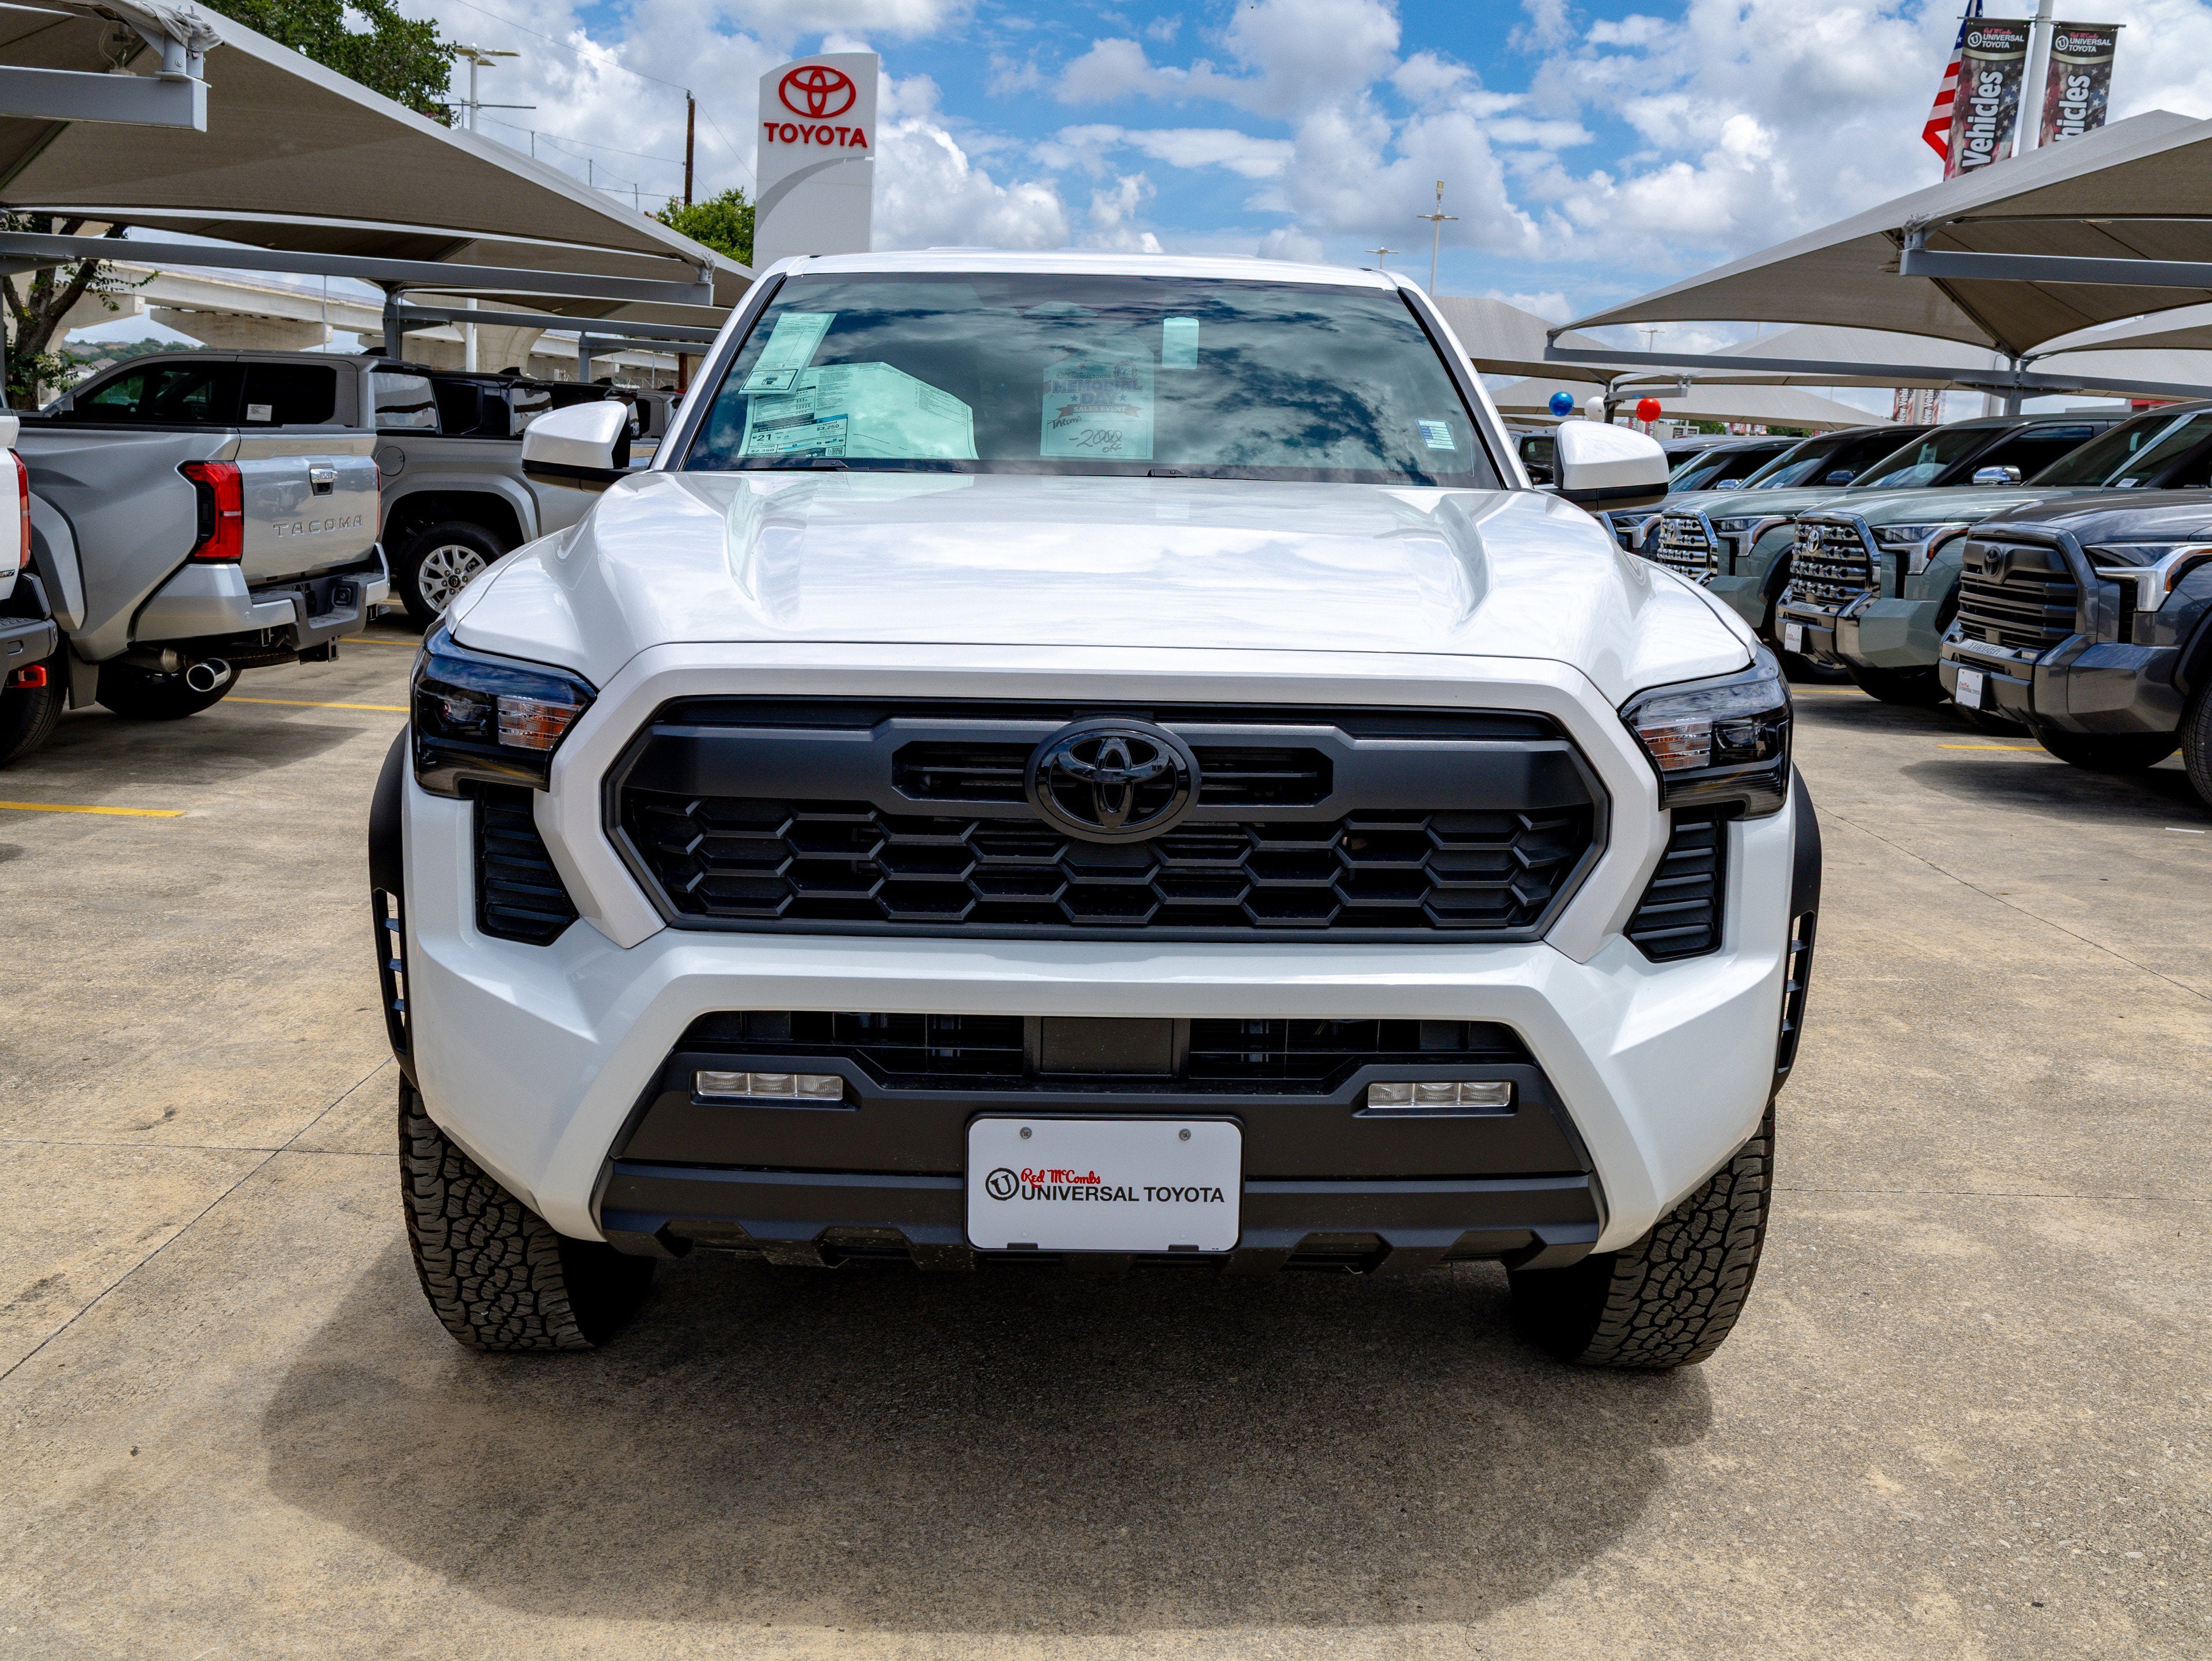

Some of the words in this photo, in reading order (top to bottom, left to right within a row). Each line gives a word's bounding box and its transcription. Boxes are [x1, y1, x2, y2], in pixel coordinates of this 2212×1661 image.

[1983, 33, 2024, 41] UNIVERSAL
[2070, 37, 2112, 46] UNIVERSAL
[1961, 71, 2003, 167] Vehicles
[764, 122, 868, 148] TOYOTA
[1053, 379, 1143, 393] MEMORIAL
[1080, 392, 1118, 405] DAY
[1897, 408, 1907, 423] New
[1922, 409, 1933, 425] New
[273, 515, 363, 538] TACOMA
[1968, 642, 2003, 656] TUNDRA
[1021, 1168, 1046, 1189] Red
[1047, 1169, 1101, 1185] McCombs
[1021, 1185, 1139, 1202] UNIVERSAL
[1143, 1186, 1225, 1203] TOYOTA
